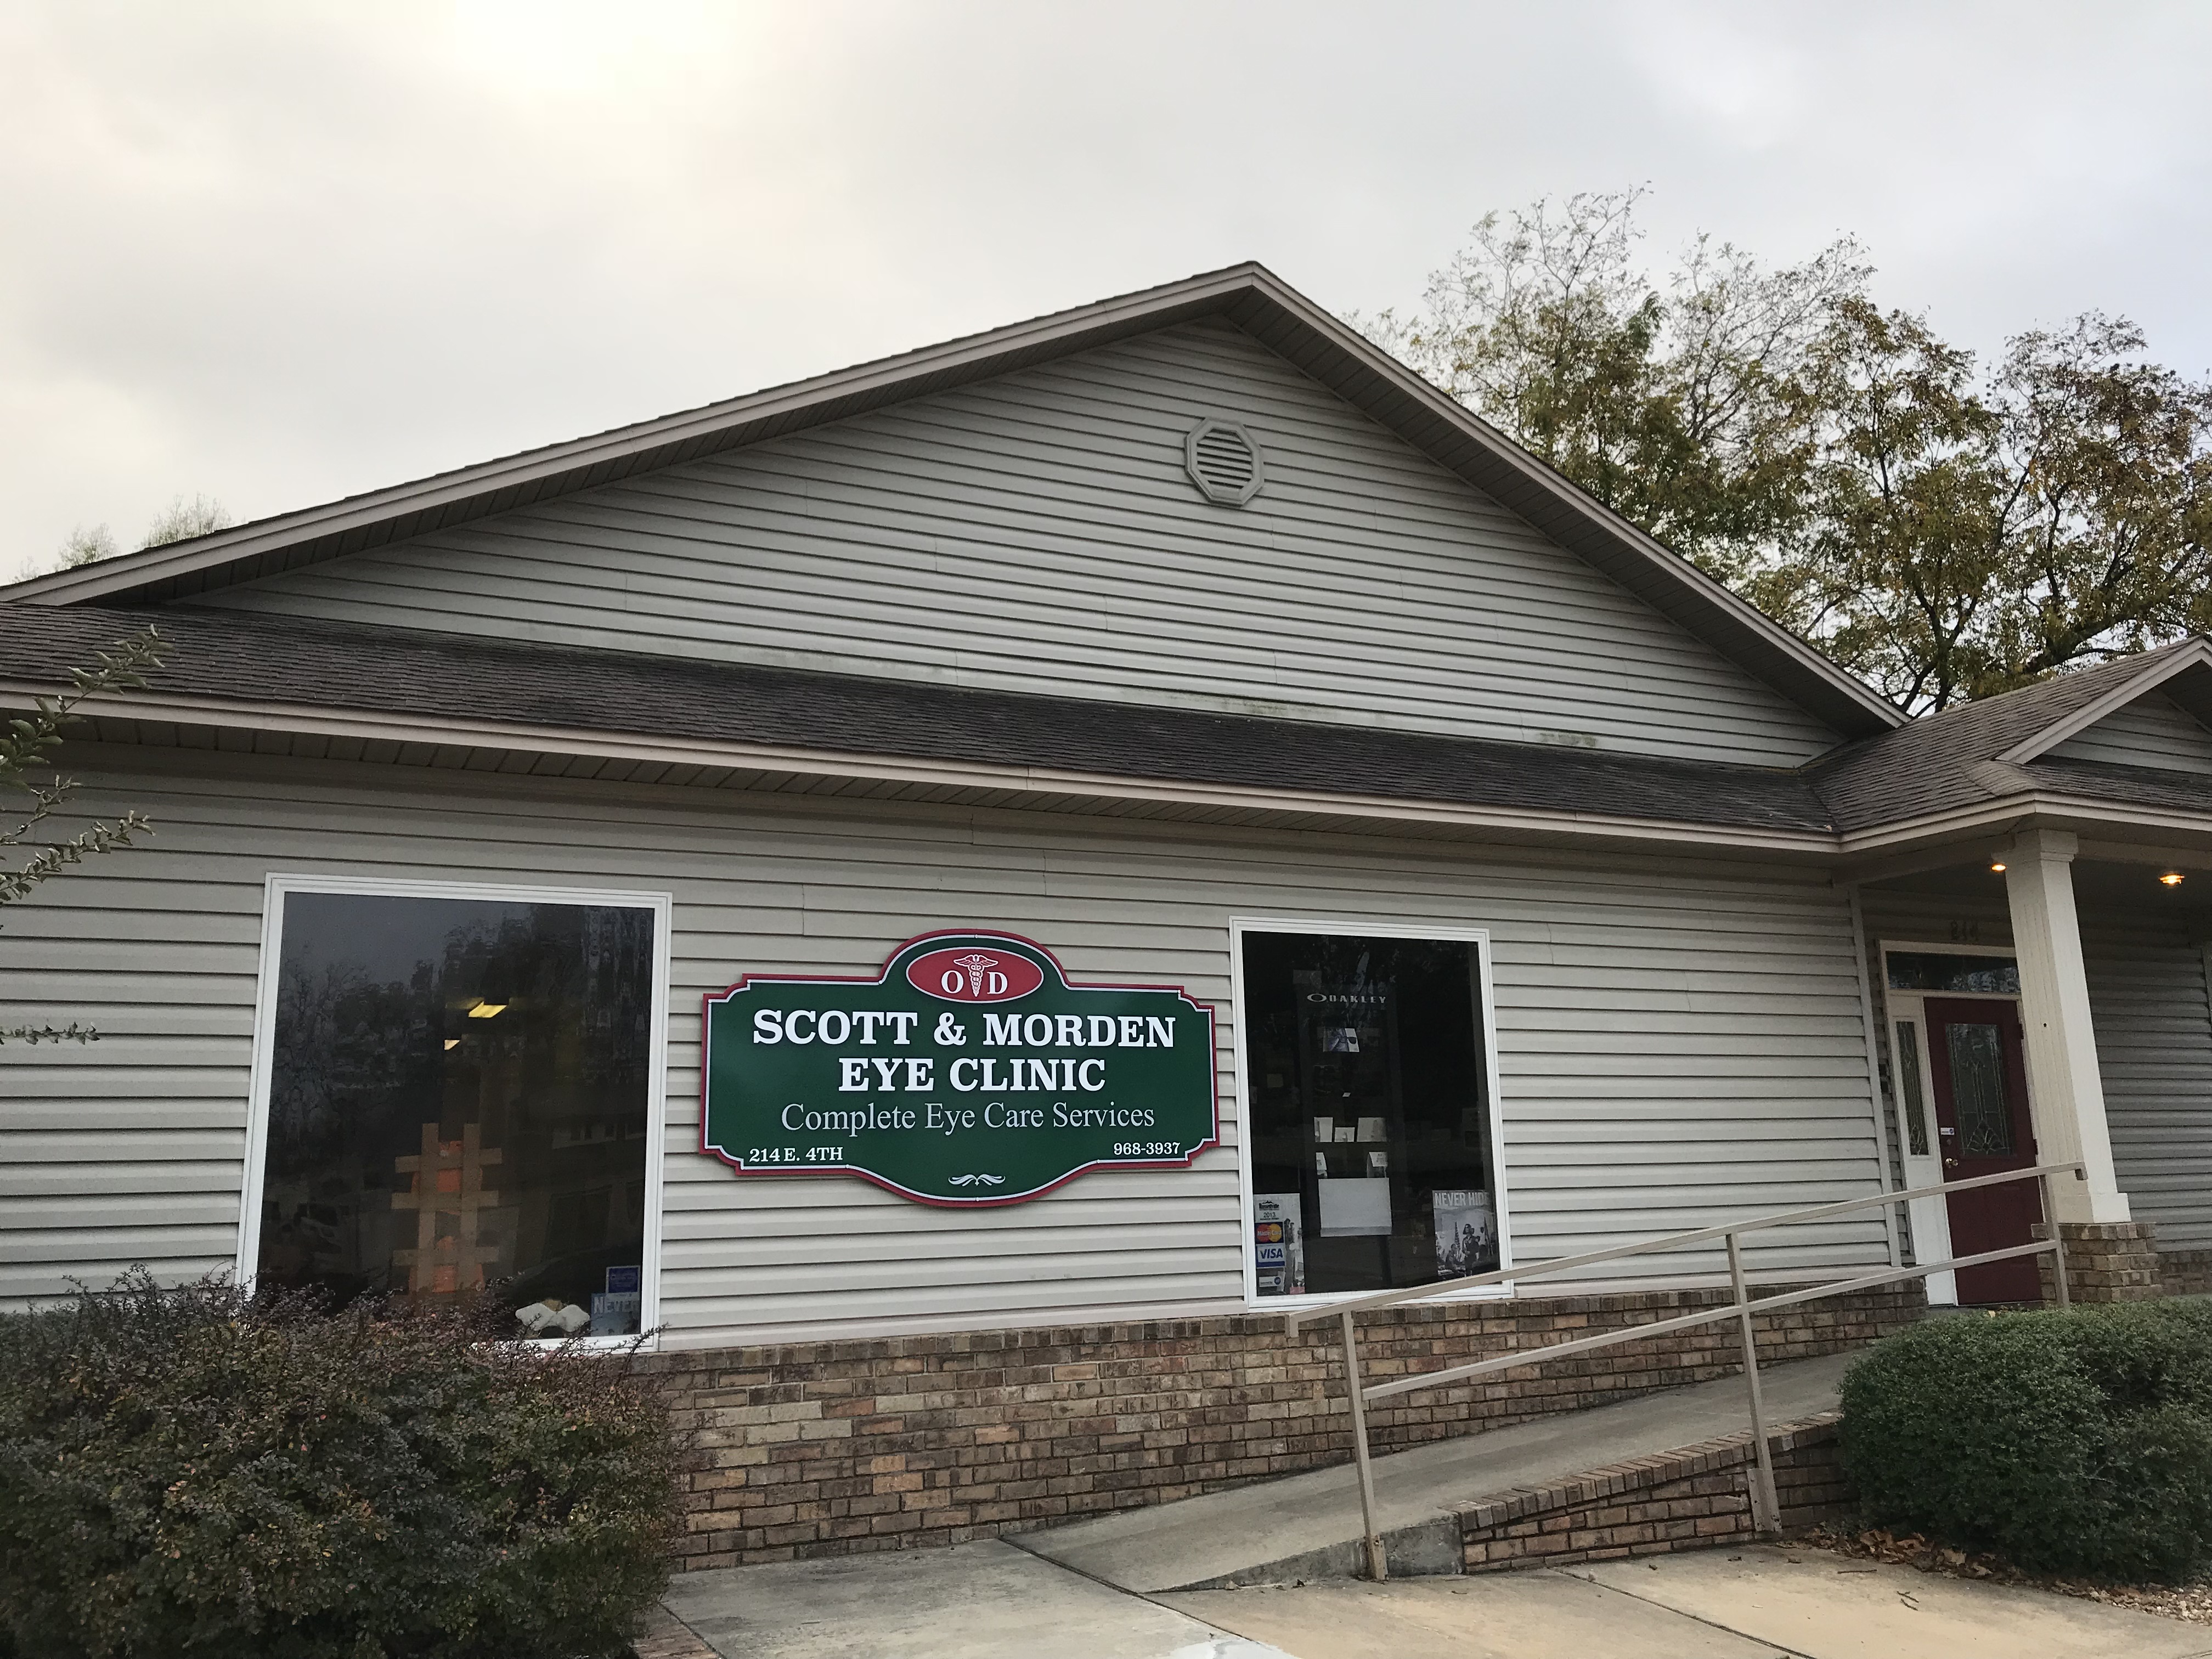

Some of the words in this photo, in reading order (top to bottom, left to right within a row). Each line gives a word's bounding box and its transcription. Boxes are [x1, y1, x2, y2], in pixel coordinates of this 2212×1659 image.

[754, 1009, 918, 1045] SCOTT
[934, 1012, 967, 1046] &
[983, 1013, 1176, 1047] MORDEN
[838, 1058, 934, 1092] EYE
[950, 1058, 1105, 1092] CLINIC
[781, 1102, 916, 1137] Complete
[924, 1103, 975, 1136] Eye
[984, 1102, 1044, 1128] Care
[1053, 1101, 1154, 1128] Services
[749, 1148, 780, 1163] 214
[783, 1148, 800, 1161] E.
[805, 1147, 843, 1161] 4TH
[1114, 1142, 1181, 1155] 968-3937
[1434, 1192, 1466, 1206] NEVER
[1260, 1248, 1283, 1259] VISA
